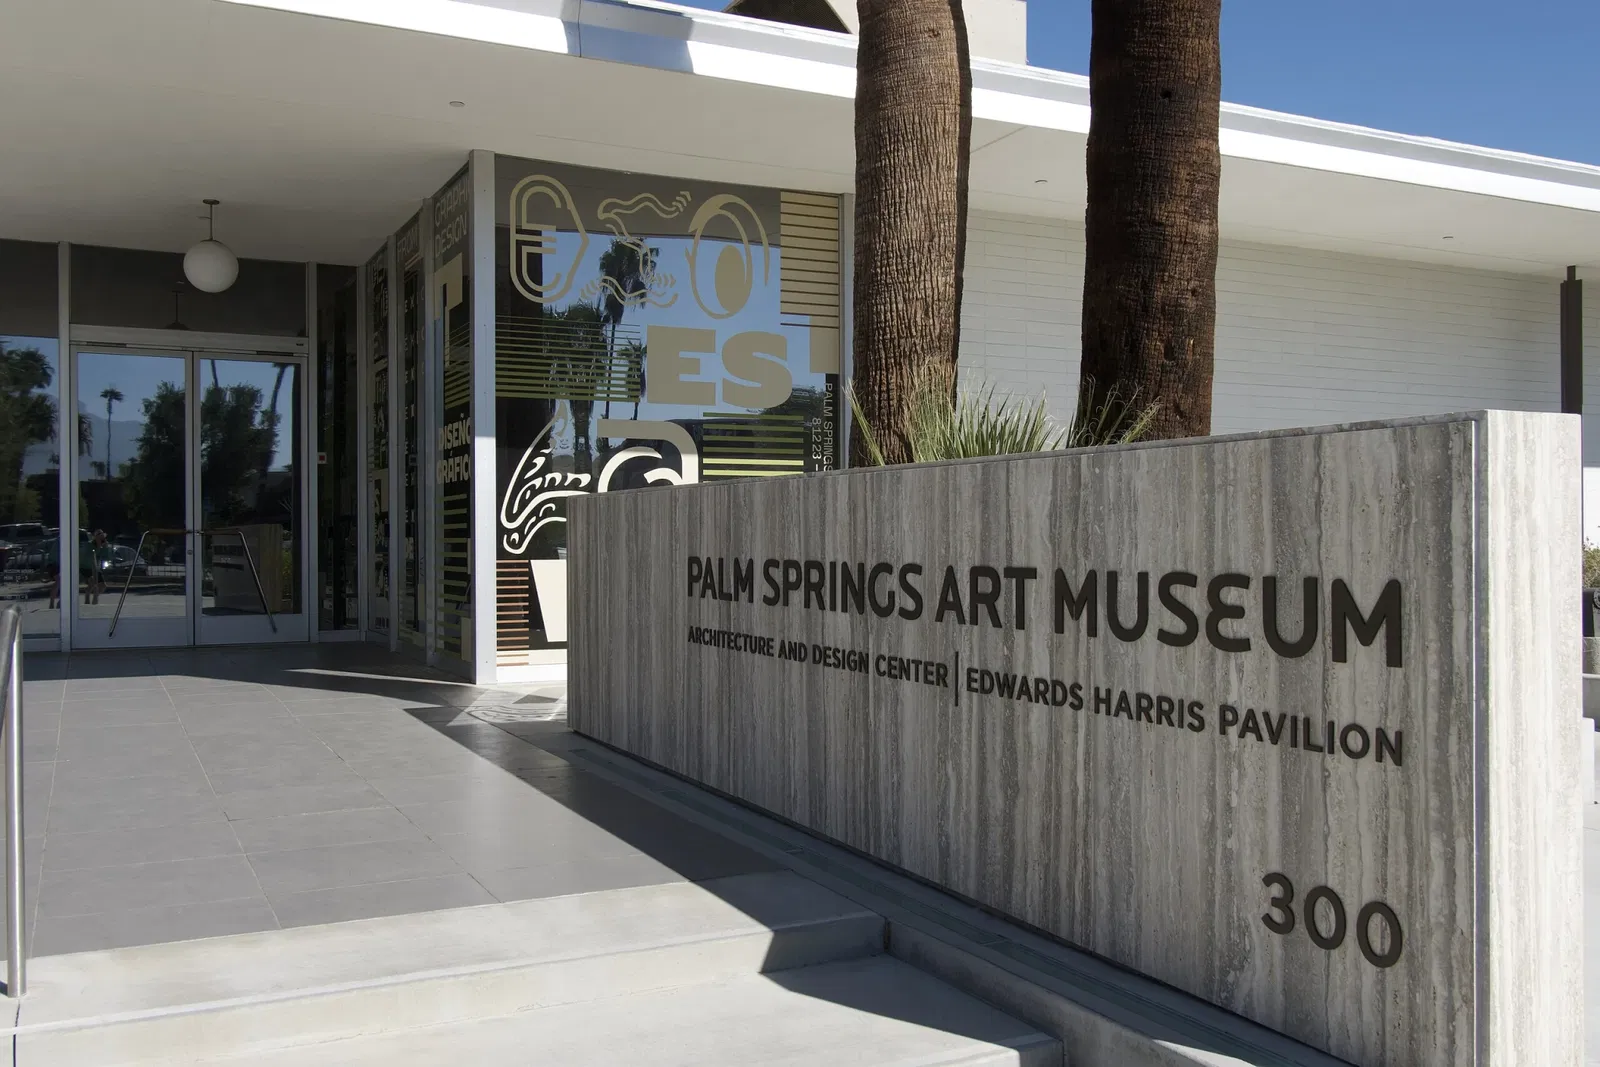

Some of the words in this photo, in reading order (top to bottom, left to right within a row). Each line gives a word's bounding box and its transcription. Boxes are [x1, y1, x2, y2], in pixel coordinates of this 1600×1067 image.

[435, 177, 470, 228] GRAPHI
[435, 211, 467, 259] DESIGN
[646, 325, 793, 409] ES
[823, 383, 833, 417] PALM
[812, 417, 822, 460] 81223
[687, 556, 754, 603] PALM
[762, 559, 924, 620] SPRINGS
[935, 565, 1038, 630] ART
[1054, 567, 1403, 668] MUSEUM
[687, 626, 775, 657] ARCHITECTURE
[778, 639, 808, 662] AND
[812, 644, 869, 675] DESIGN
[875, 654, 949, 688] CENTER
[966, 667, 1084, 711] EDWARDS
[1093, 686, 1205, 733] HARRIS
[1219, 704, 1403, 767] PAVILION
[1261, 872, 1403, 968] 300
